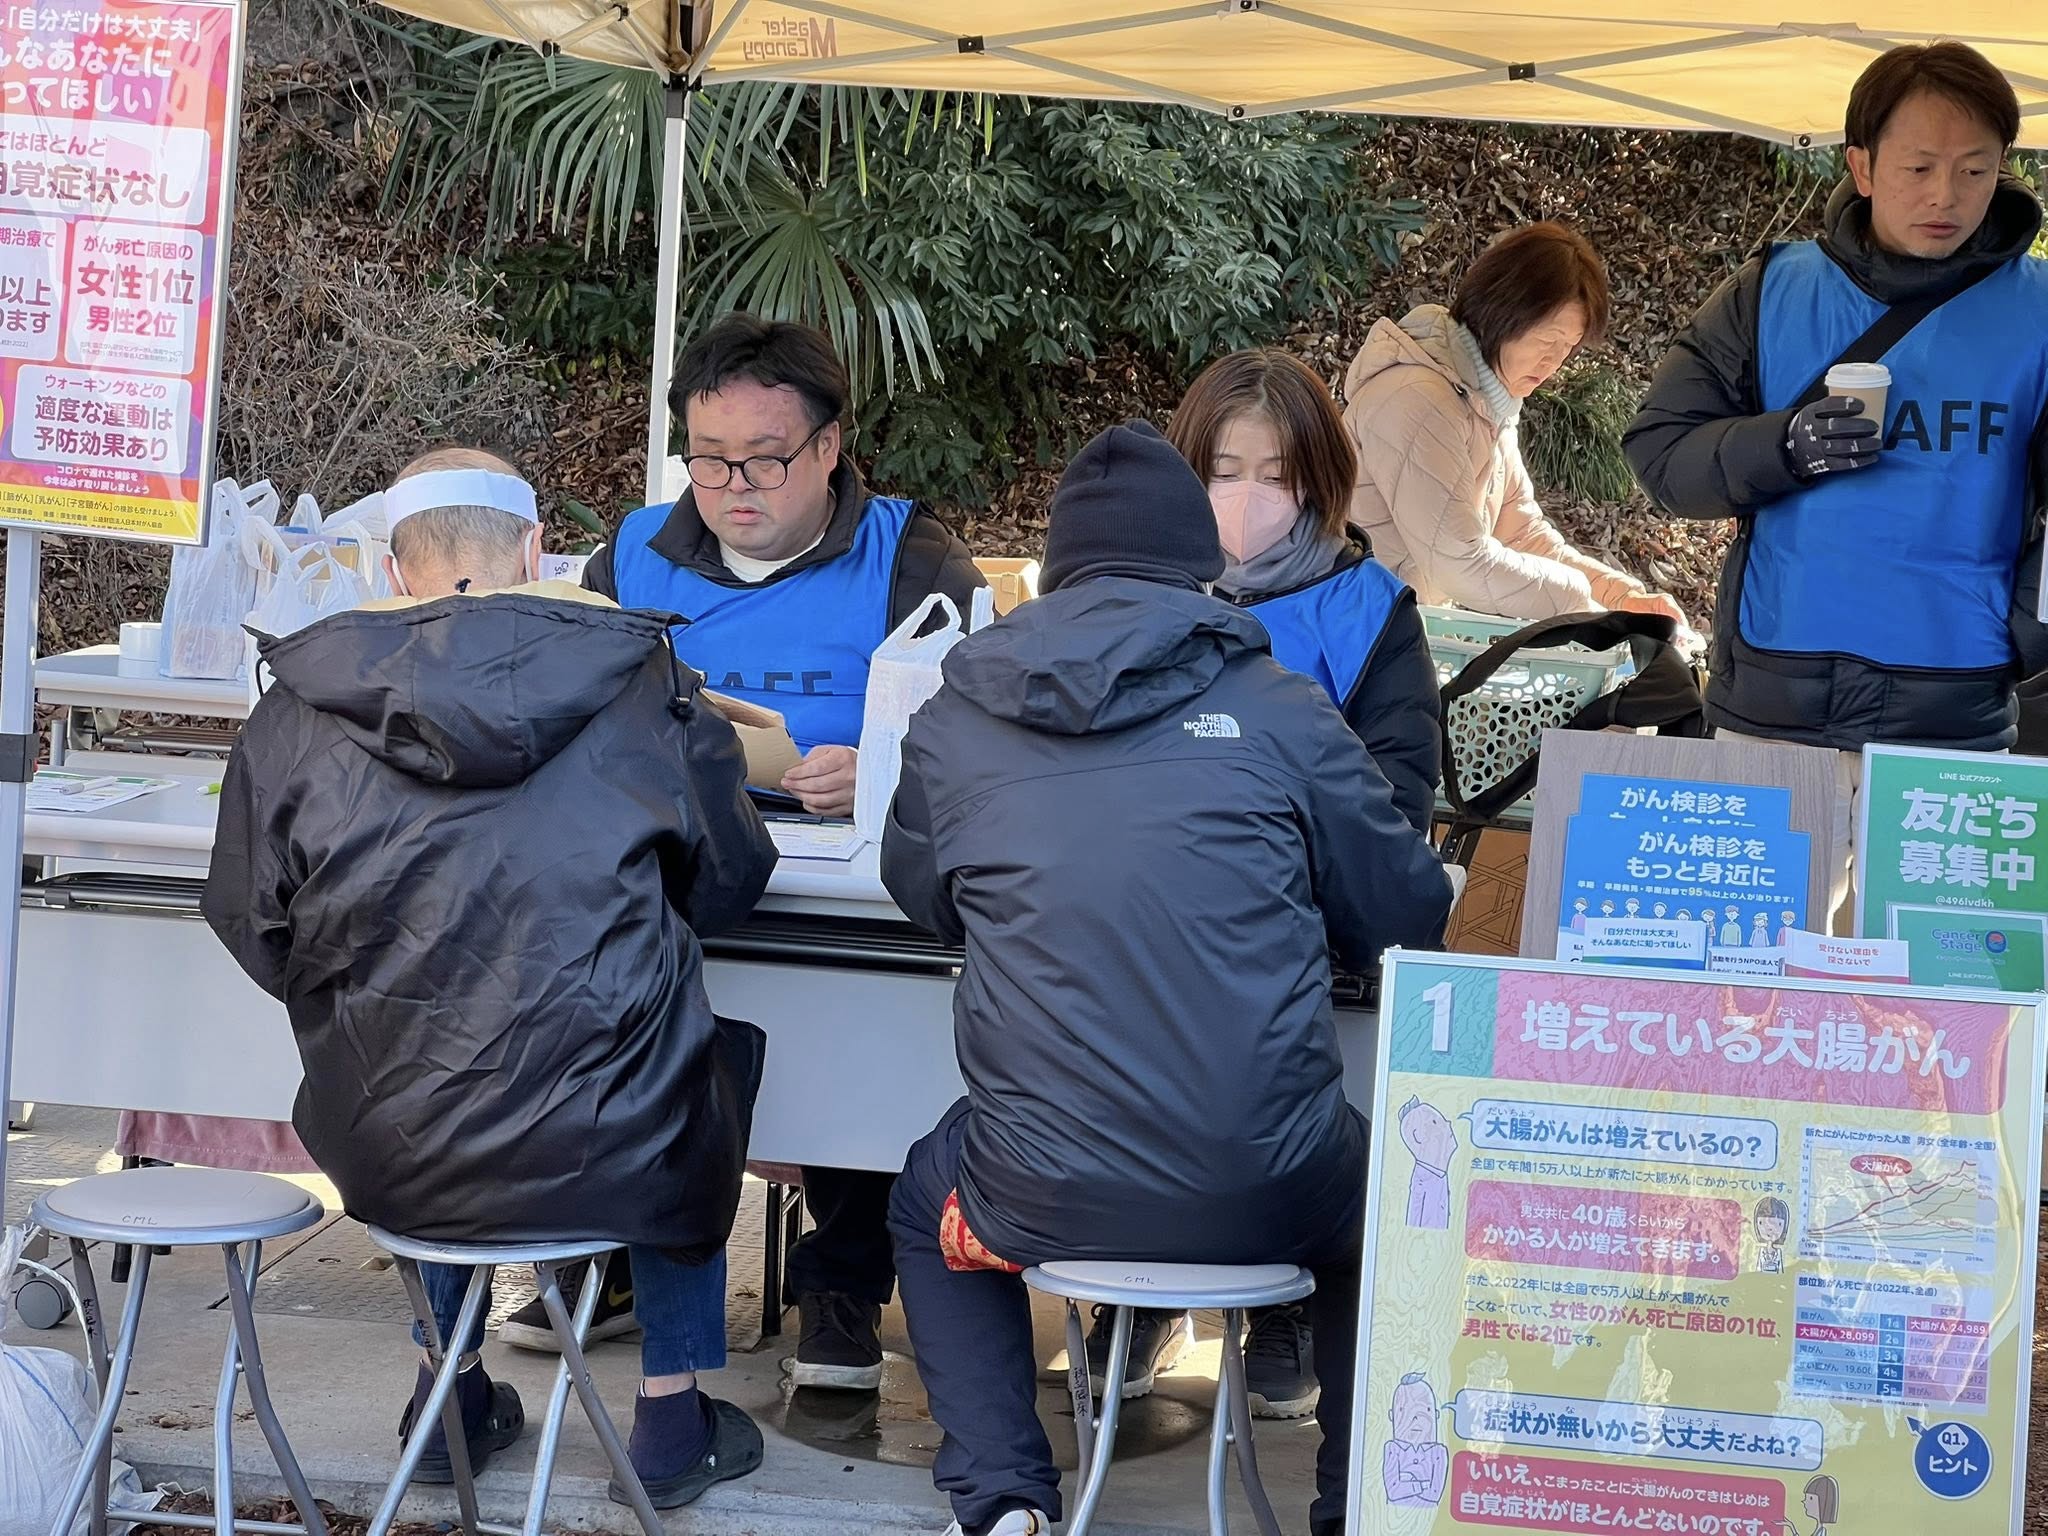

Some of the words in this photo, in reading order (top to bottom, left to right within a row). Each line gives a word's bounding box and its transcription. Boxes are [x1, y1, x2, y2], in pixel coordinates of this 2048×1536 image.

[0, 6, 201, 43] 「自分だけは大丈夫」
[0, 159, 190, 209] 覚症状なし
[84, 234, 194, 260] がん死亡原因の
[77, 260, 195, 305] 女性1位
[86, 305, 178, 339] 男性2位
[44, 374, 167, 399] ウォーキングなどの
[34, 394, 173, 431] 適度な運動は
[1884, 400, 2008, 455] AFF
[33, 425, 169, 462] 予防効果あり
[43, 475, 150, 495] 今年は必ず取り戻しましょう
[1184, 721, 1220, 731] NORTH
[1199, 714, 1220, 722] THE
[1194, 730, 1221, 738] FACE
[1939, 772, 1958, 781] LINE
[1620, 787, 1748, 817] がん検診を
[1901, 788, 2038, 839] 友だち
[1638, 831, 1767, 861] がん検診を
[1626, 856, 1776, 887] もっと身近に
[1899, 840, 2035, 891] 募集中
[1590, 938, 1692, 950] そんなあなたに知ってほしい
[1603, 927, 1679, 939] 「自分だけは大丈夫」
[1931, 928, 1981, 941] Cancer
[1941, 939, 1983, 953] Stage
[1818, 943, 1880, 956] 受けない理由を
[1421, 981, 1454, 1053] 1
[1776, 1006, 1803, 1018] だい
[1824, 1009, 1859, 1022] ちょう
[1519, 999, 1971, 1079] 増えている大腸がん
[1485, 1116, 1762, 1158] 大腸がんは増えているの?
[1805, 1127, 1911, 1144] 新たにがんにかかった人数
[1471, 1157, 1793, 1194] 全国で年間15万人以上が新たに大腸がんにかかっています。
[122, 1214, 158, 1226] CML
[1482, 1224, 1721, 1264] かかる人が増えてきます。
[1124, 1275, 1155, 1285] CML
[1462, 1318, 1602, 1348] 男性では2位です。
[1484, 1408, 1801, 1457] 症状が無いから大丈夫だよね?
[1942, 1432, 1966, 1445] Q1.
[1929, 1455, 1978, 1475] ヒント
[1469, 1460, 1771, 1507] いいえ、こまったことに大腸がんのできはじめは
[1459, 1490, 1770, 1536] 自覚症状がほとんどないのです。
